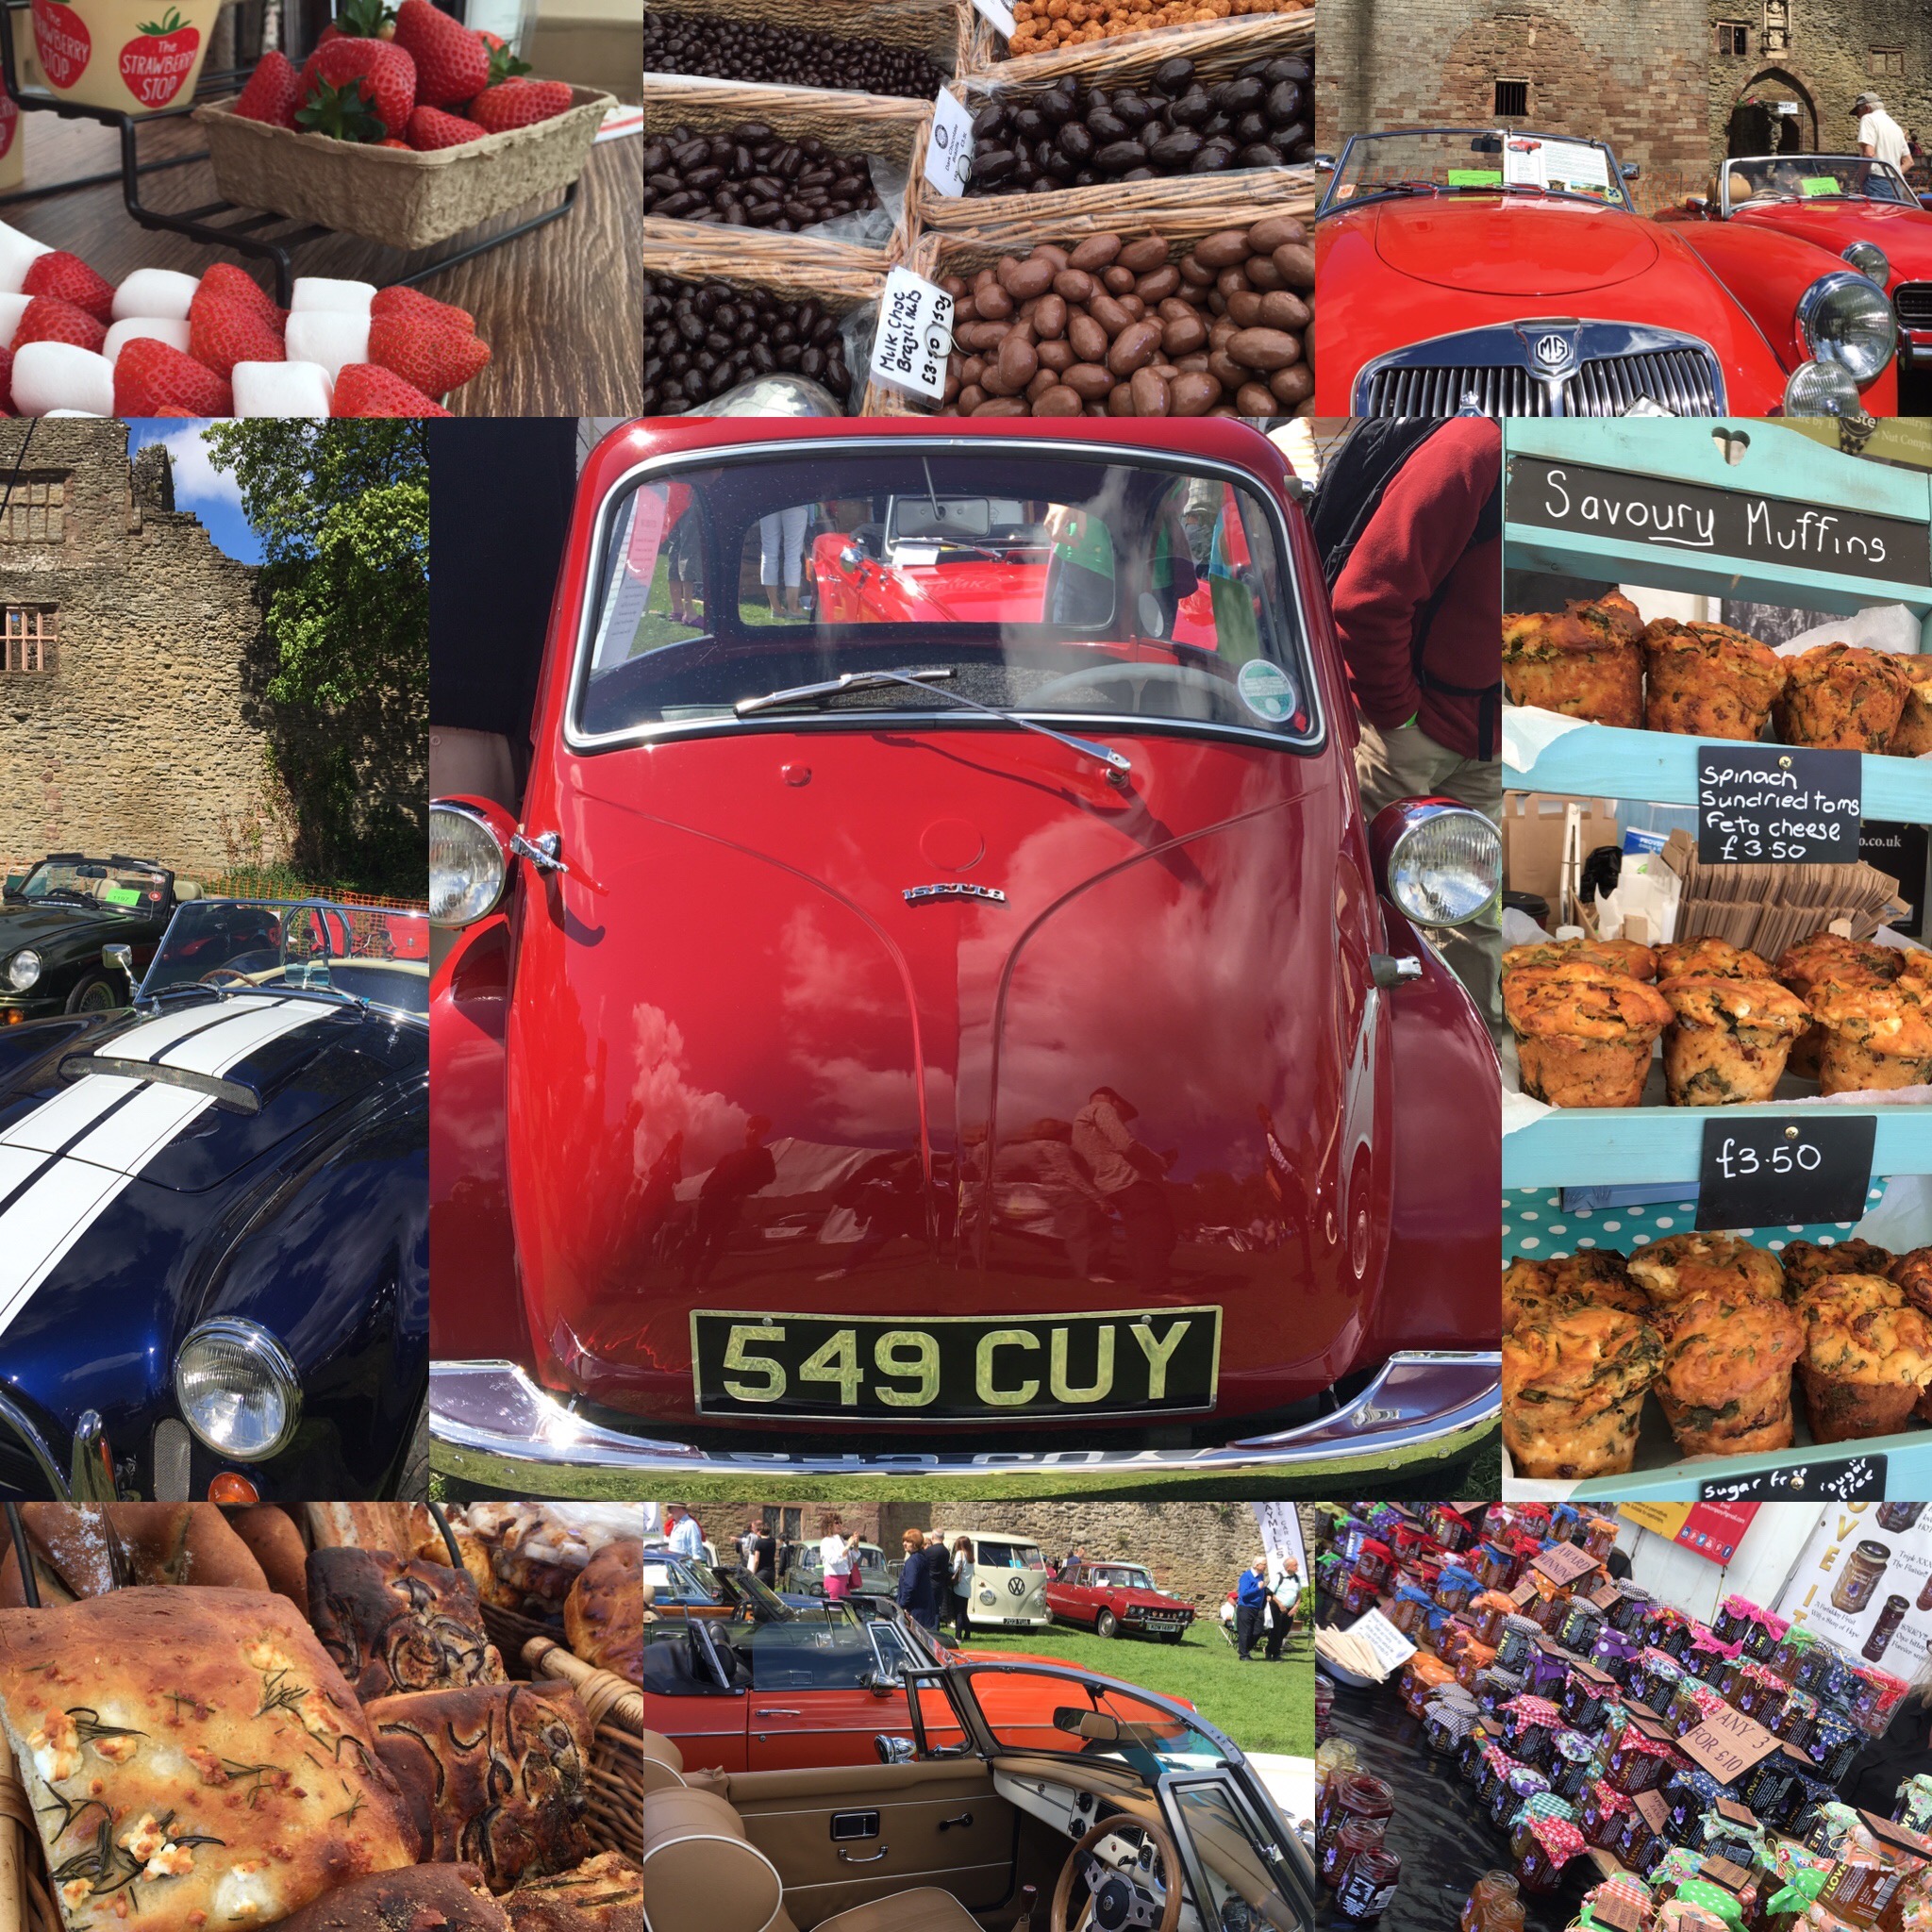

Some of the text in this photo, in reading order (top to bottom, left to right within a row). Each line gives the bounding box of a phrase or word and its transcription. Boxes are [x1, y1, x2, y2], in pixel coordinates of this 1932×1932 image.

[158, 40, 178, 54] The
[140, 75, 178, 101] STOP
[888, 291, 906, 329] Choc
[905, 290, 922, 321] Nuts
[1540, 337, 1566, 360] MG
[1881, 429, 1898, 443] Nut
[1545, 470, 1888, 563] Savoury Muffins
[1700, 765, 1798, 789] Spinach
[1701, 790, 1860, 818] Sundried toms
[1769, 817, 1840, 841] cheese
[1720, 835, 1807, 861] £3.50
[1715, 1139, 1822, 1178] £3.50
[722, 1320, 1192, 1407] 549 CUY
[1705, 1477, 1762, 1501] sugar
[1537, 1553, 1575, 1582] WINNING
[1556, 1547, 1591, 1571] AWARD
[1497, 1639, 1508, 1656] LOVE
[1688, 1725, 1720, 1754] FOR
[1715, 1712, 1771, 1749] ANY 3
[1746, 1775, 1759, 1794] LOVE
[1324, 1820, 1341, 1843] LOVE
[1826, 1863, 1849, 1893] LOVE
